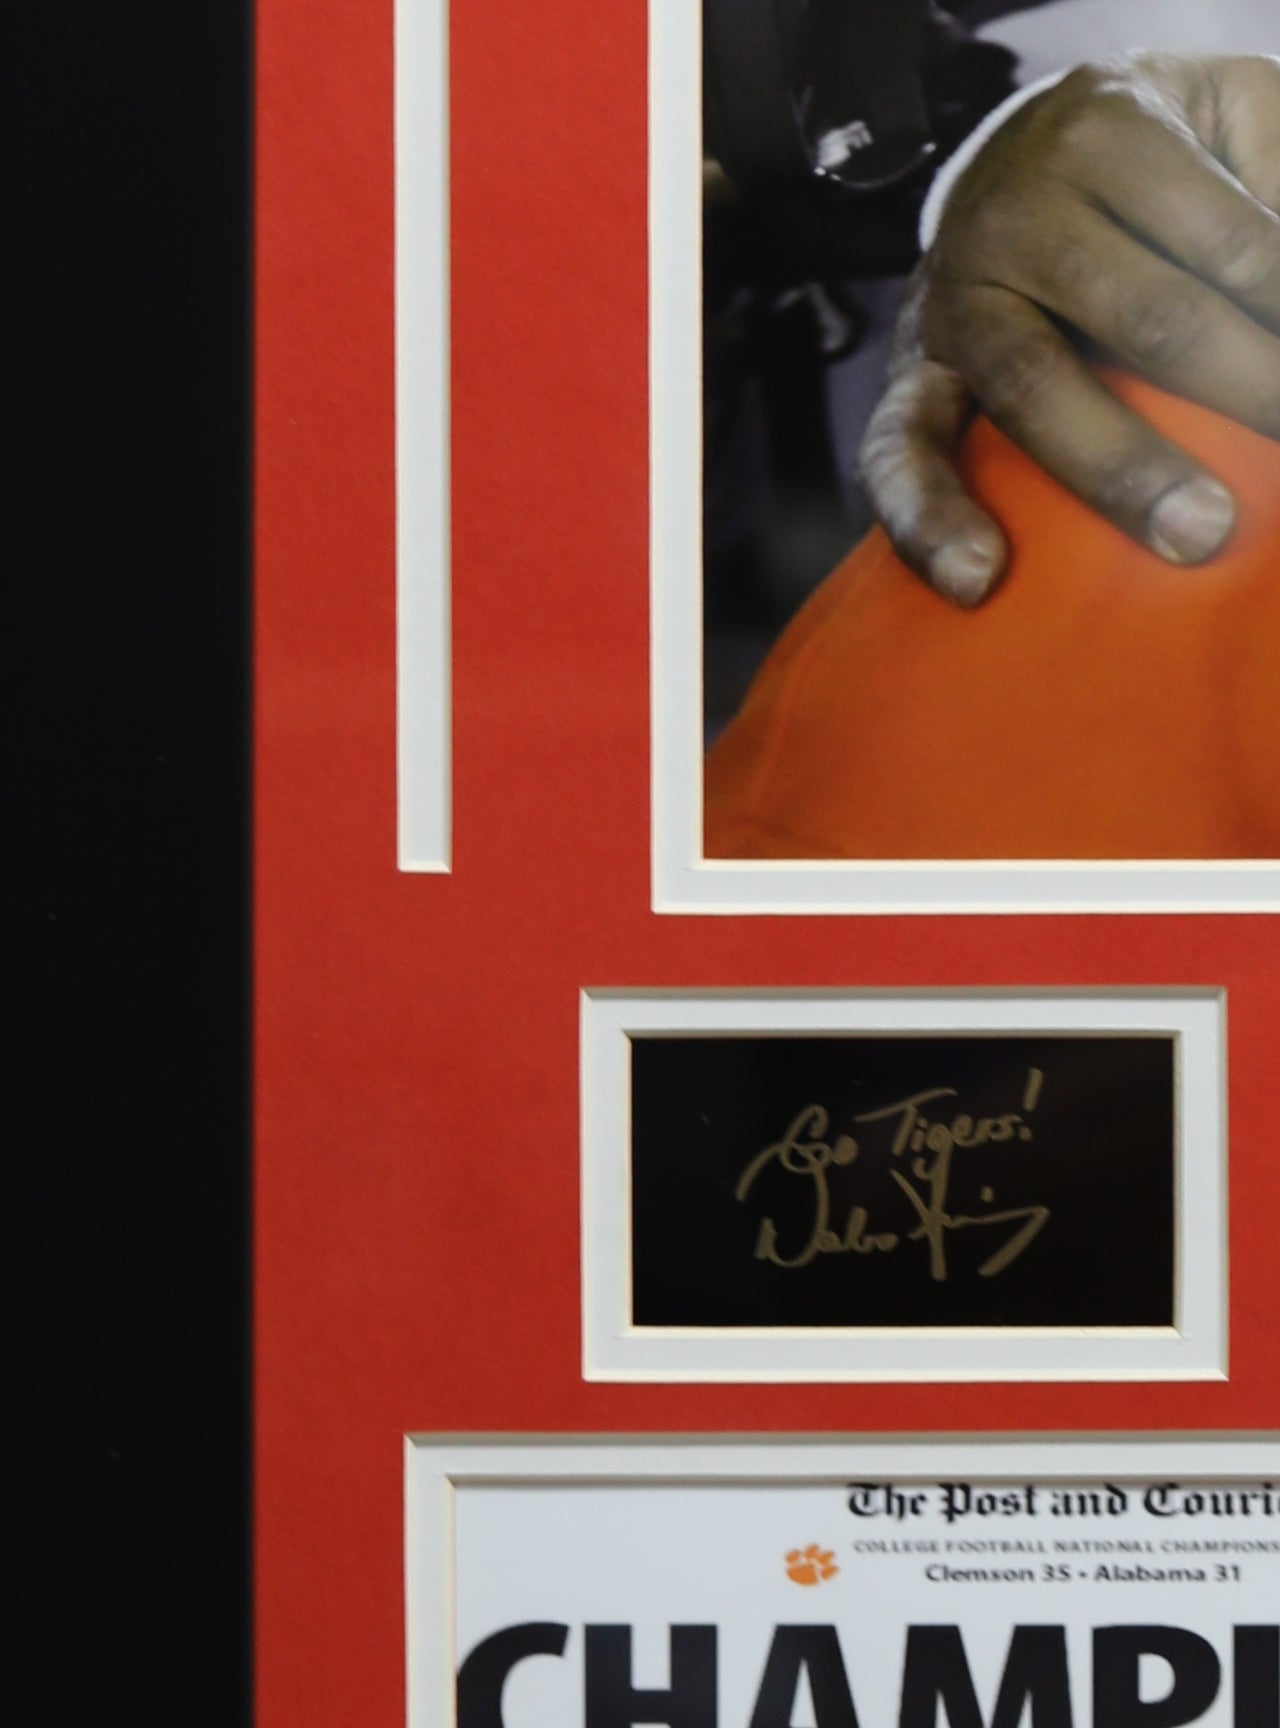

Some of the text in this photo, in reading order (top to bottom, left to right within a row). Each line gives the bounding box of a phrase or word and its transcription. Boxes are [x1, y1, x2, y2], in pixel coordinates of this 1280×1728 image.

[846, 1480, 928, 1522] The
[936, 1481, 1037, 1524] Post
[1050, 1481, 1128, 1517] and
[853, 1538, 940, 1554] COLLEGE
[946, 1538, 1047, 1554] FOOTBALL
[1054, 1538, 1155, 1554] NATIONAL
[925, 1563, 1240, 1583] Clemson 35 Alabama 31
